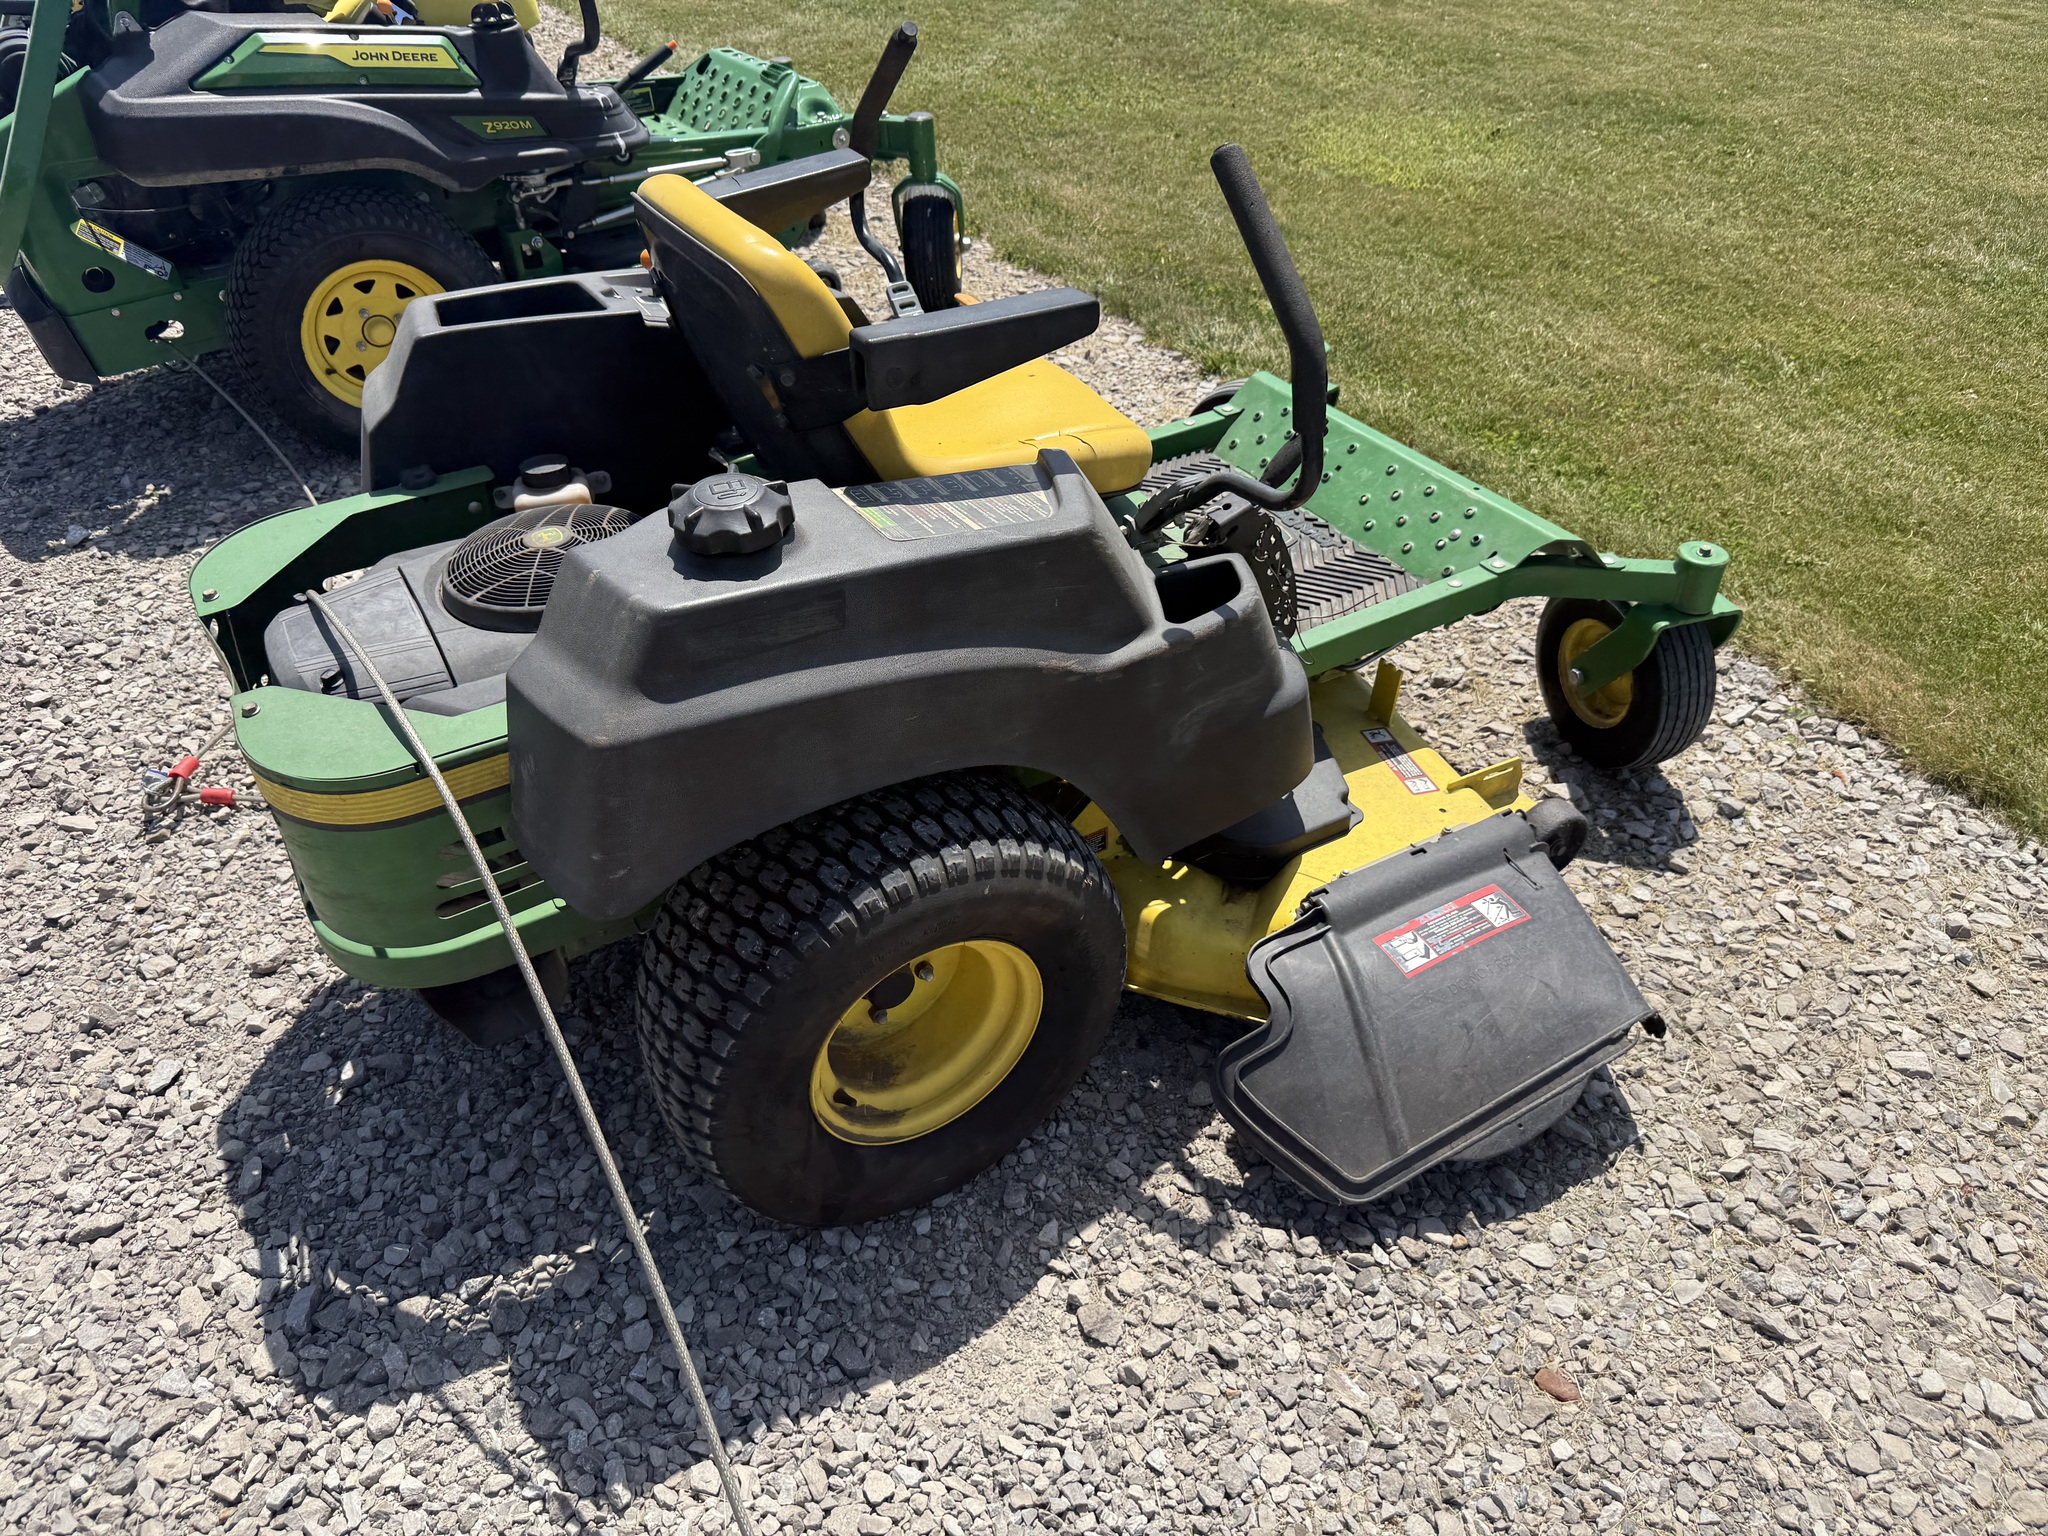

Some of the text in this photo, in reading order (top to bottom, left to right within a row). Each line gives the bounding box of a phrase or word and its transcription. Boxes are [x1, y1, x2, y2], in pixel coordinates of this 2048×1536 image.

[352, 49, 438, 62] JOHN DEERE
[482, 119, 533, 134] Z920M
[1447, 977, 1468, 995] DO
[1469, 963, 1495, 984] NOT
